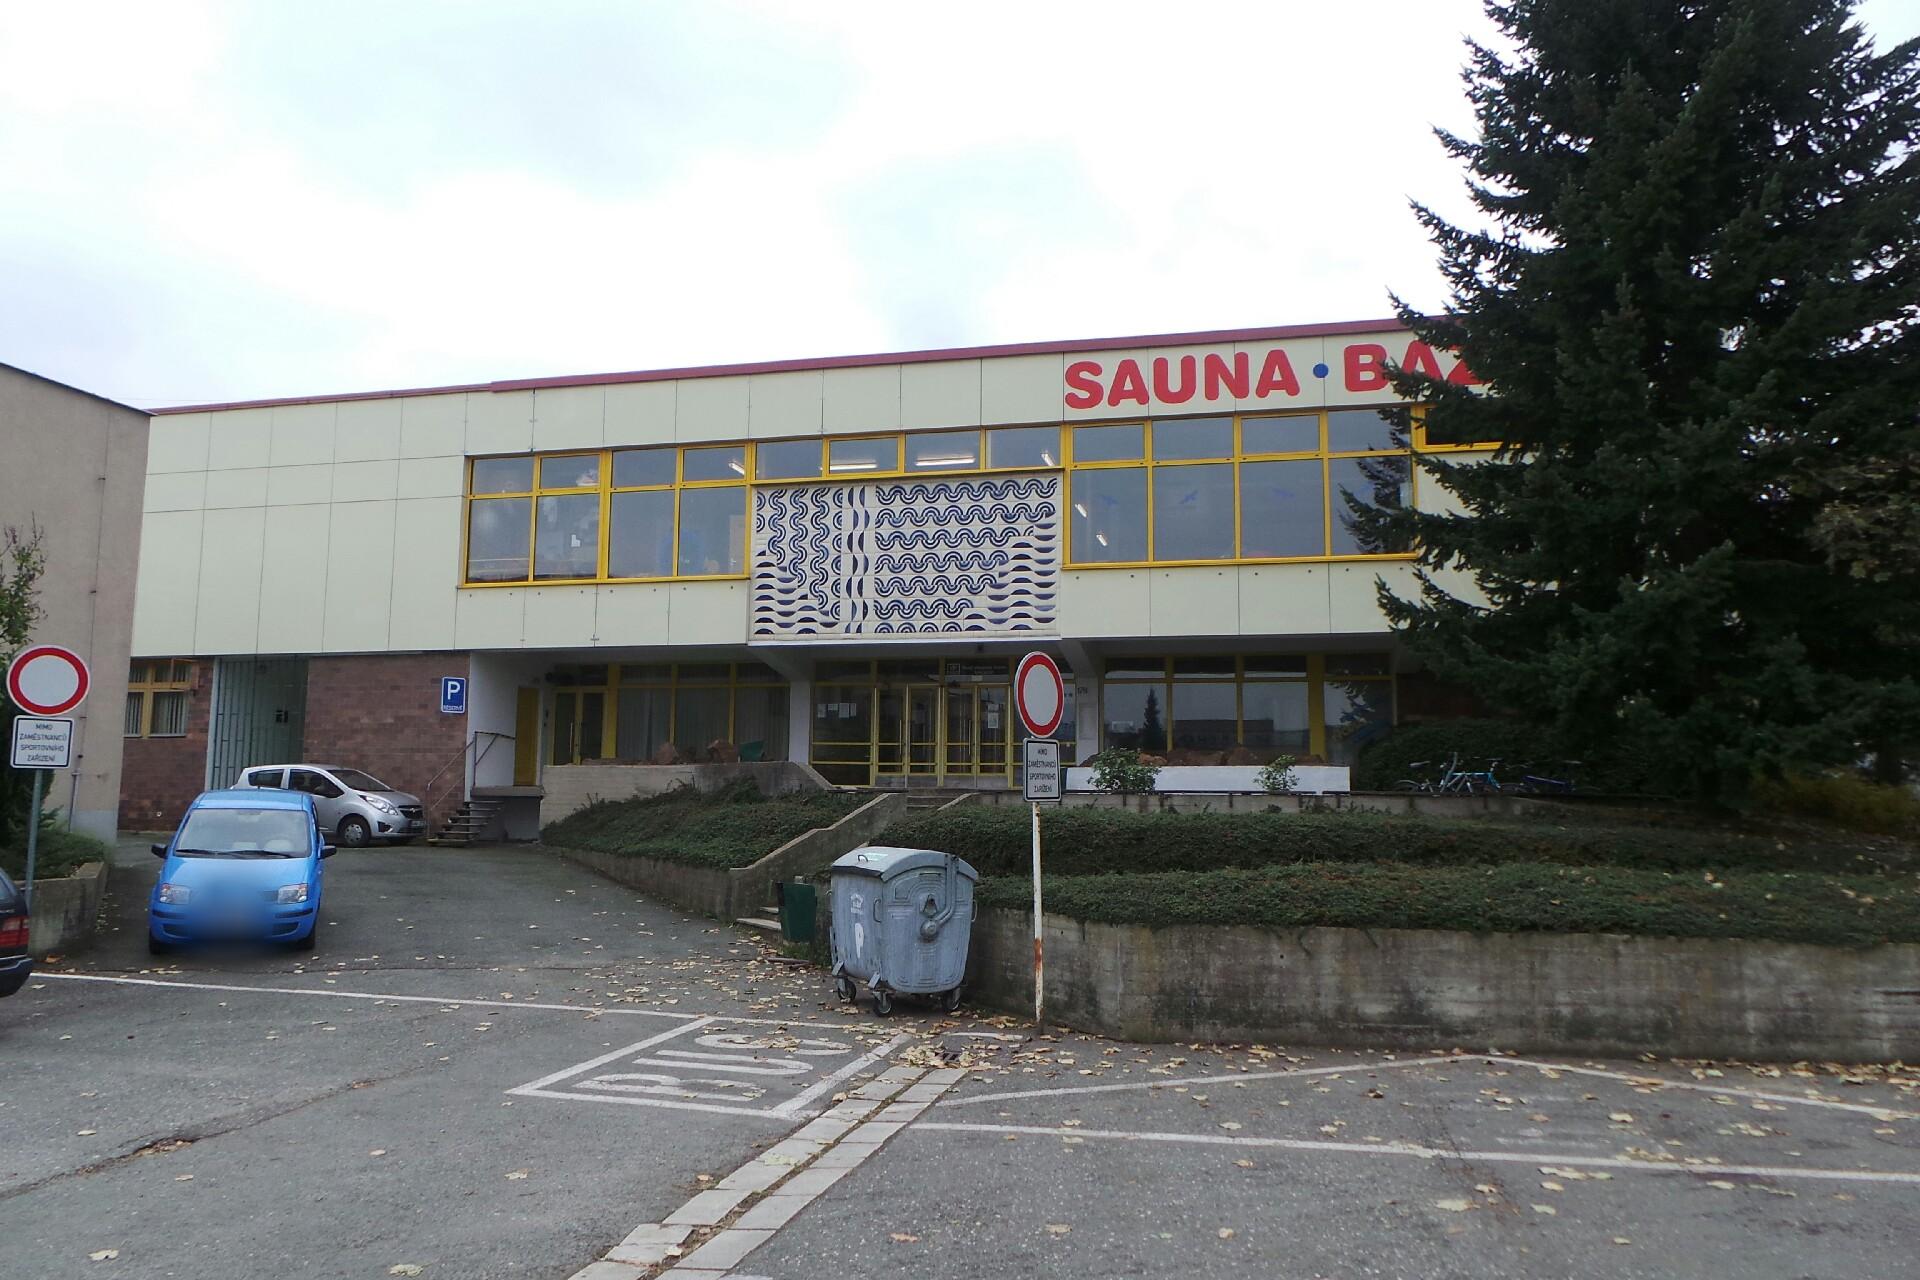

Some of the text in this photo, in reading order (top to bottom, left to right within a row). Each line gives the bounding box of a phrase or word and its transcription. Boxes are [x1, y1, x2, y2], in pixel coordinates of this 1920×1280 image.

[1064, 348, 1300, 410] SAUNA
[447, 680, 460, 700] P
[571, 1033, 853, 1101] BUS
